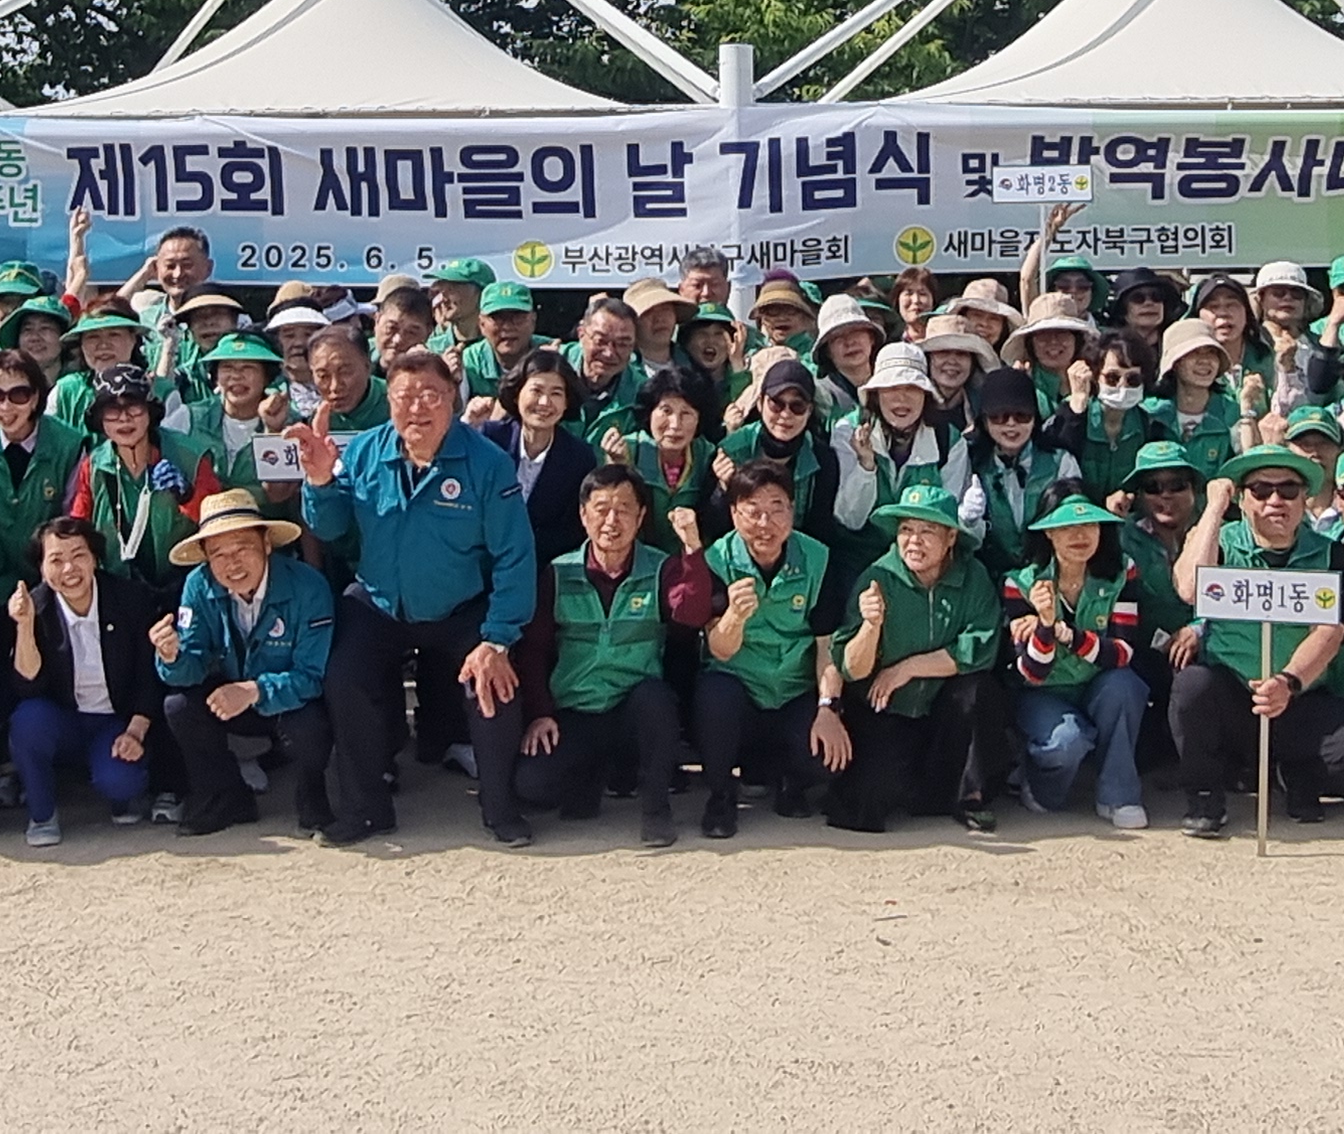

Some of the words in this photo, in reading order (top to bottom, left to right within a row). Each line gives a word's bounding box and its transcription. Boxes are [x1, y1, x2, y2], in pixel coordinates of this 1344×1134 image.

[66, 140, 285, 216] 제15회
[313, 144, 596, 220] 새마을의
[626, 141, 693, 219] 날
[719, 131, 931, 214] 기념식
[1016, 172, 1072, 195] 화명2동
[241, 244, 346, 270] 2025.
[365, 246, 397, 270] 6.
[561, 235, 849, 273] 부산광역시구새마을회
[1232, 579, 1310, 613] 화명1동
